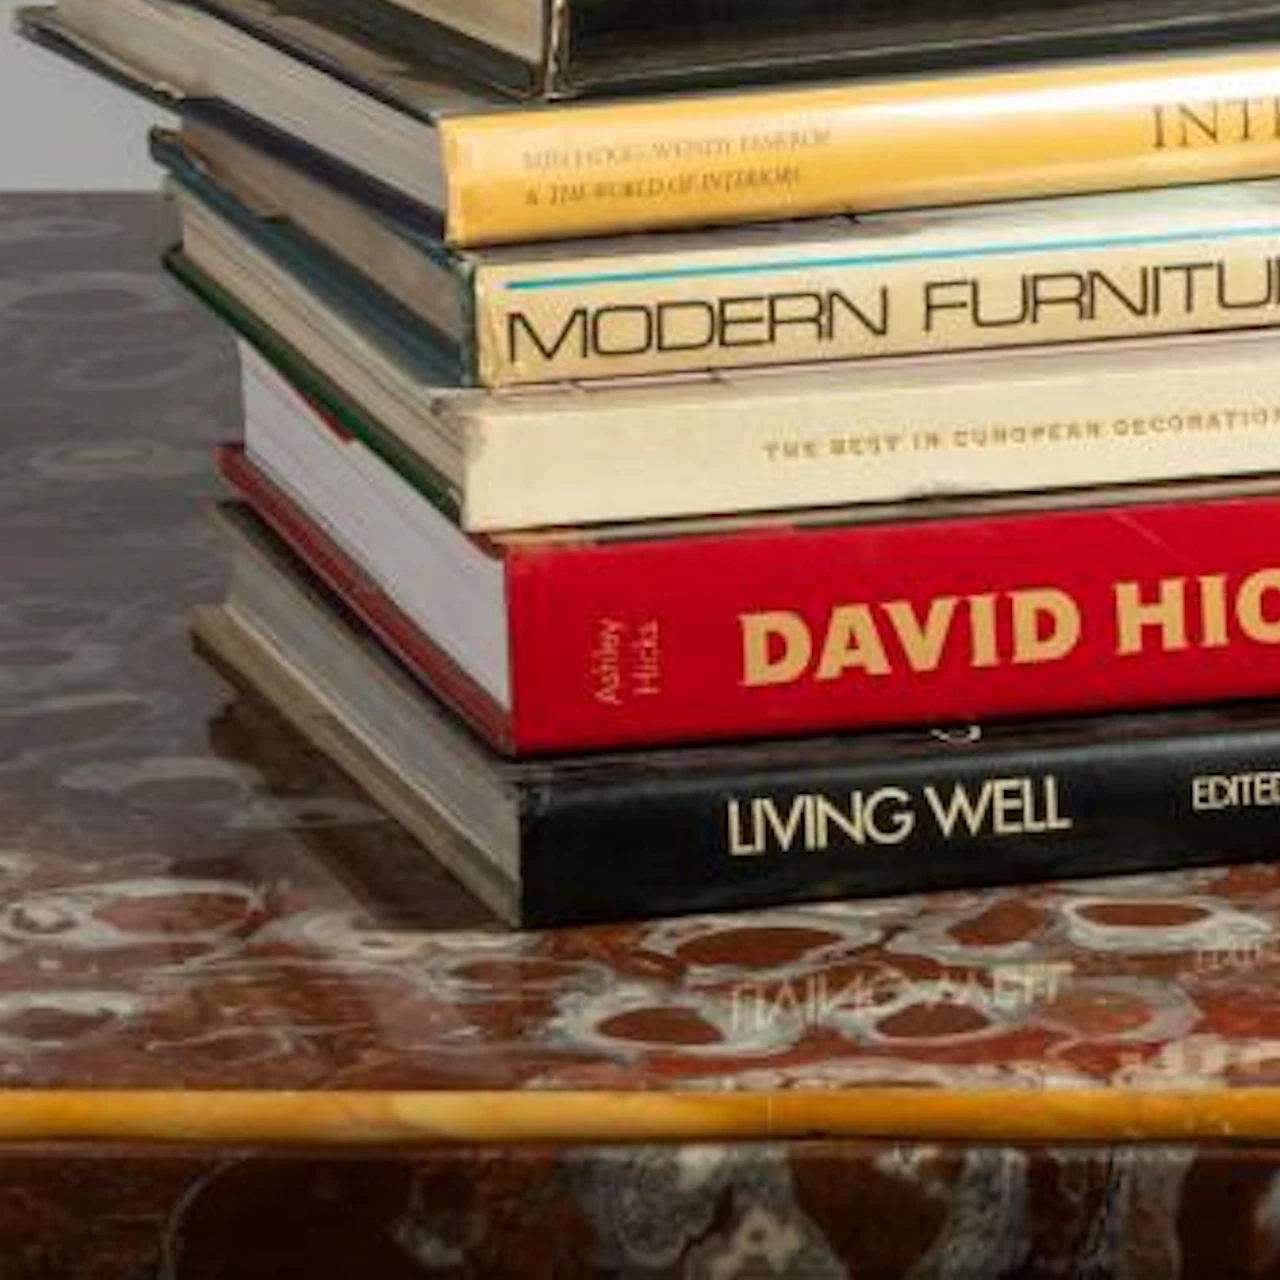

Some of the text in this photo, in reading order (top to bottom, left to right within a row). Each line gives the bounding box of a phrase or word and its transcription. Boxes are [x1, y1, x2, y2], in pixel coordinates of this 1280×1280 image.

[507, 285, 888, 365] MODERN
[766, 442, 817, 462] THE
[829, 437, 899, 458] BEST
[912, 433, 939, 452] IN
[952, 422, 1102, 448] EUROPEAN
[737, 587, 1082, 688] DAVID
[727, 787, 915, 857] LIVING
[924, 774, 1072, 836] WELL
